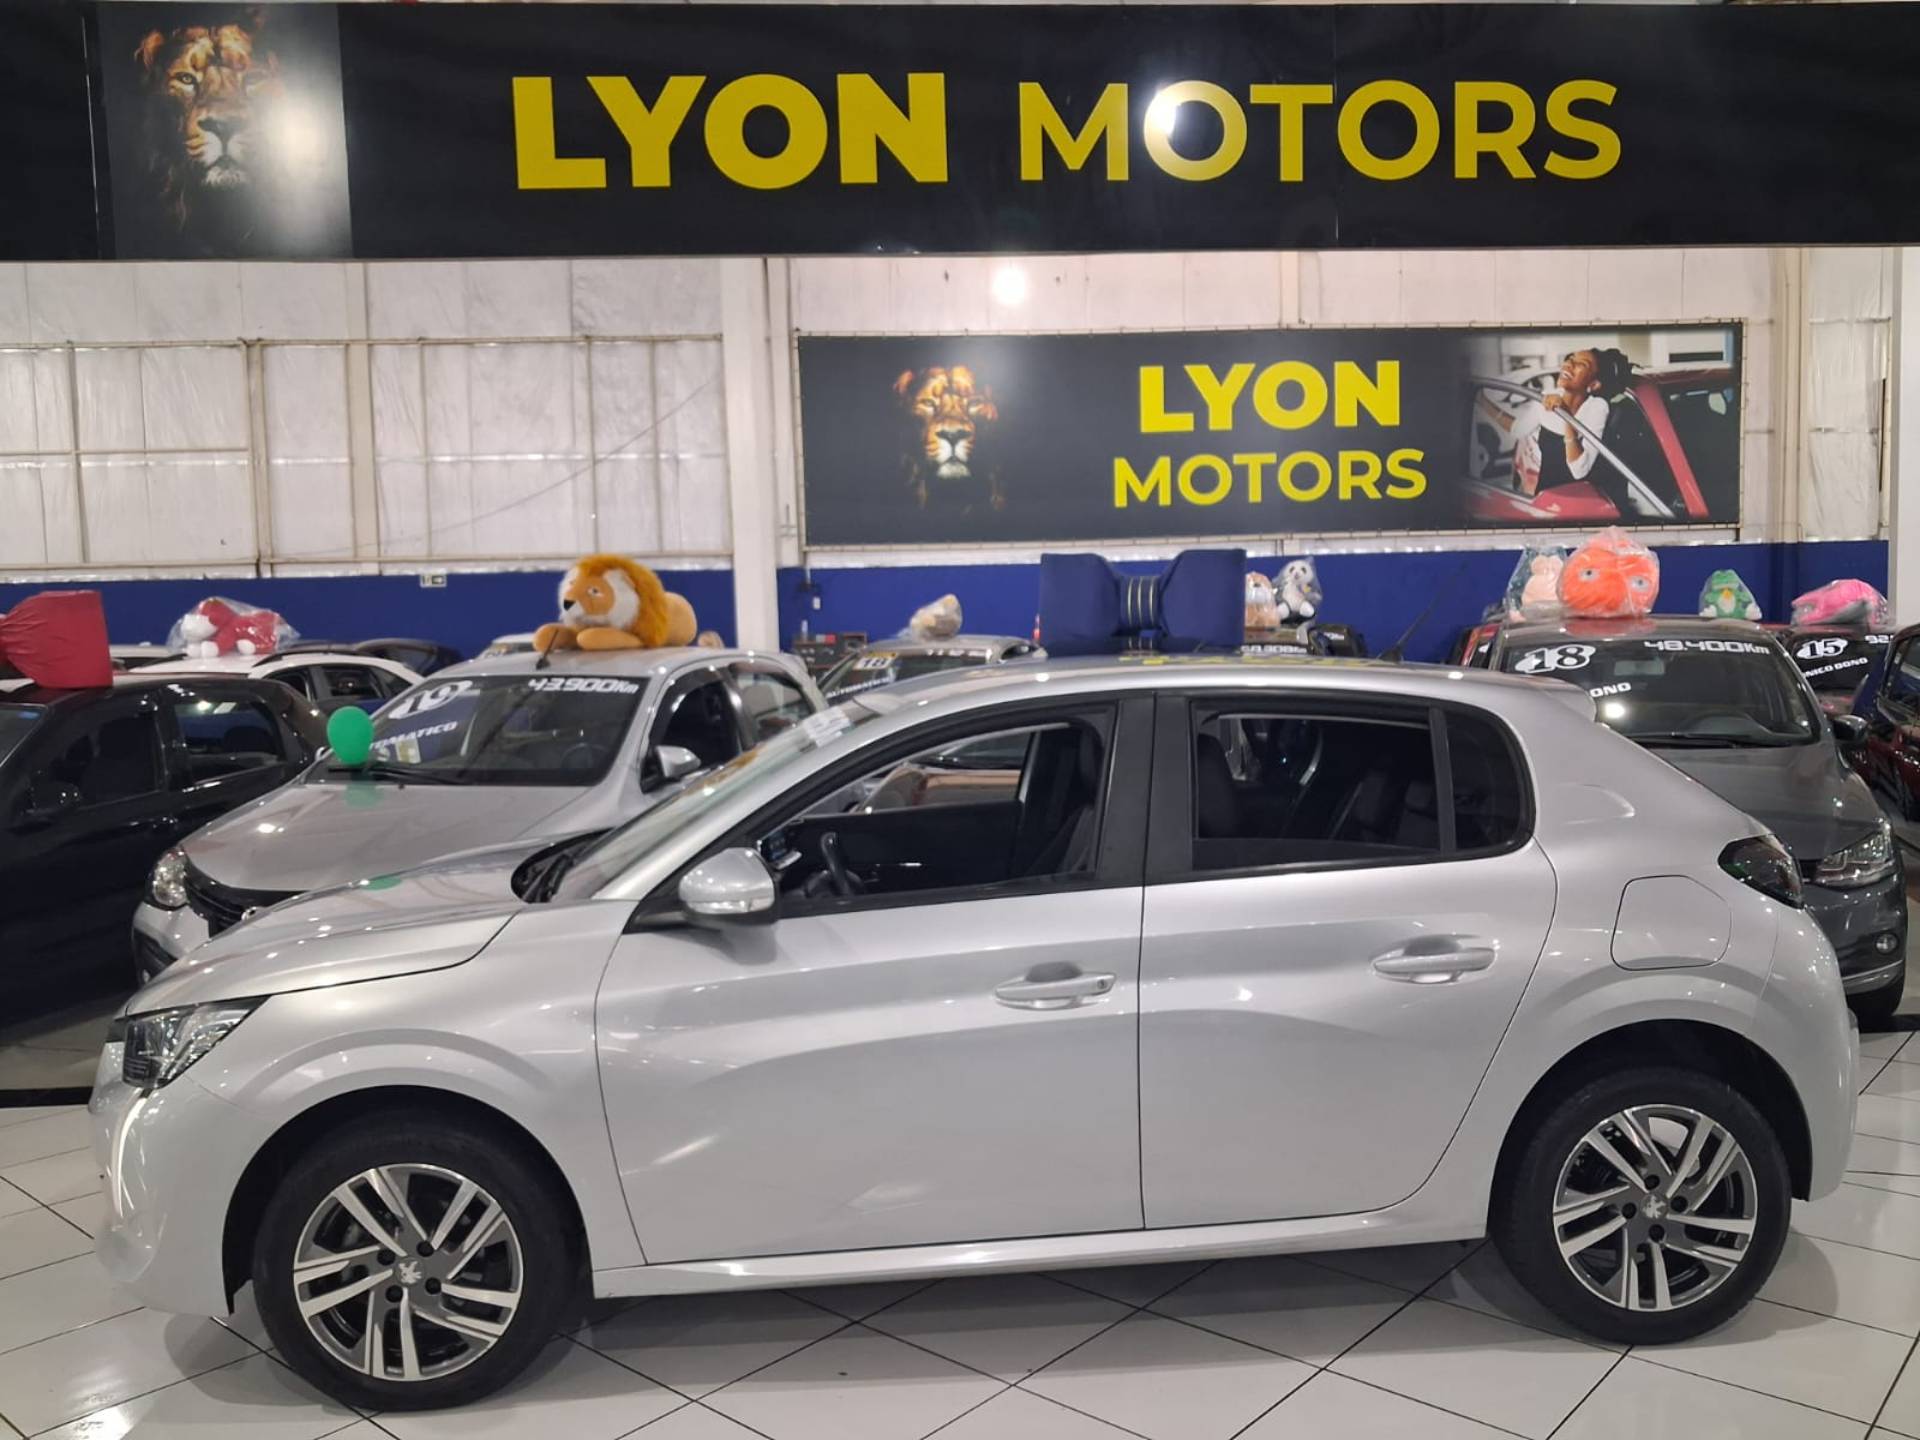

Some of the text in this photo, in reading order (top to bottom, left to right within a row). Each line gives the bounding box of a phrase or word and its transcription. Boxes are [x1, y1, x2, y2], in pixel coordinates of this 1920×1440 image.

[512, 73, 1621, 189] LYON MOTORS
[1140, 360, 1400, 432] LYON
[1114, 448, 1427, 507] MOTORS
[1521, 644, 1590, 672] 18
[1803, 638, 1843, 658] 15
[1805, 664, 1833, 676] NICO
[1590, 682, 1631, 697] ONO
[368, 720, 458, 750] TOMATICO
